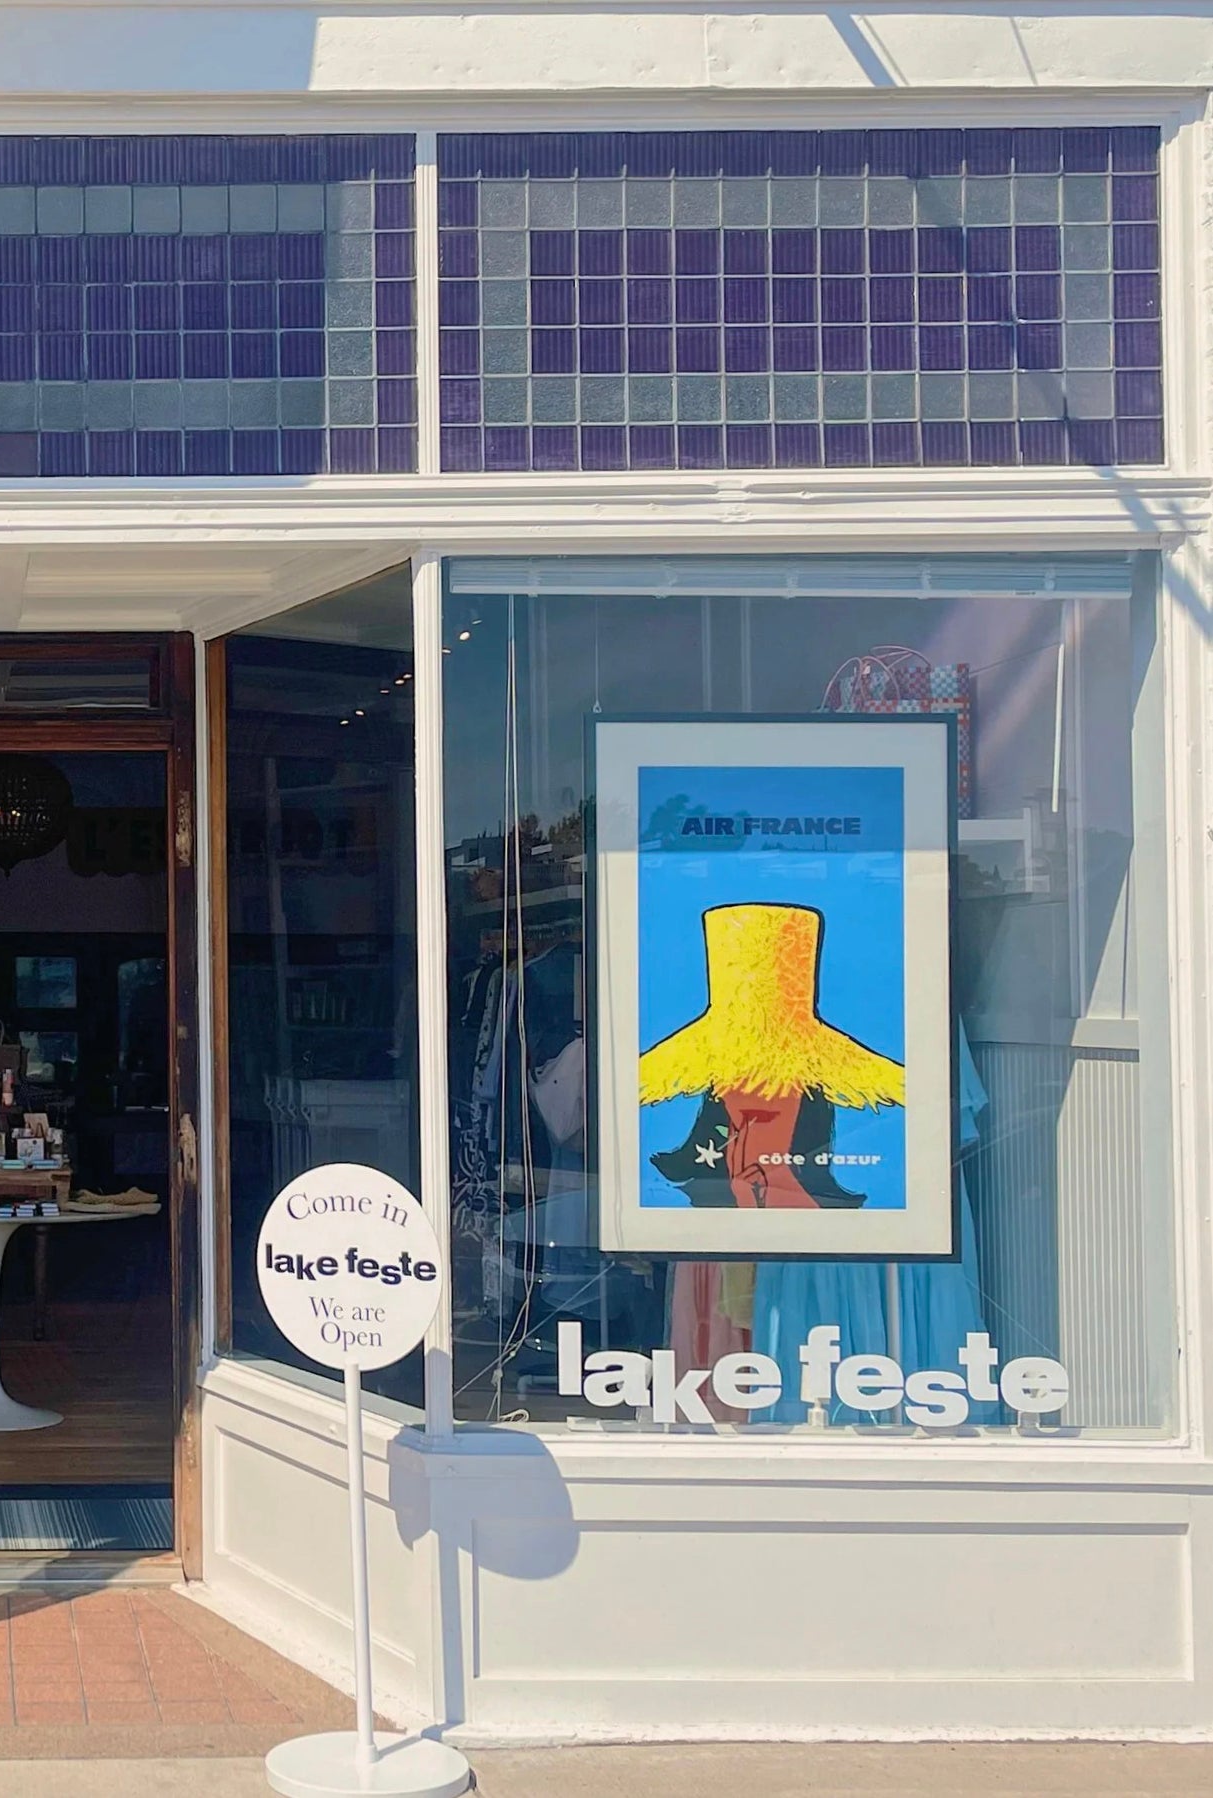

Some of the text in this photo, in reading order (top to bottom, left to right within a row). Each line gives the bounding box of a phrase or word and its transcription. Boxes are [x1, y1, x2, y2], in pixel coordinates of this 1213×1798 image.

[681, 816, 861, 836] AIR FRANCE
[757, 1152, 882, 1166] côte d'azur
[286, 1192, 409, 1229] Come in
[265, 1243, 437, 1286] lake feste
[308, 1296, 386, 1323] We are
[320, 1322, 383, 1352] Open
[556, 1320, 1069, 1428] lake feste
